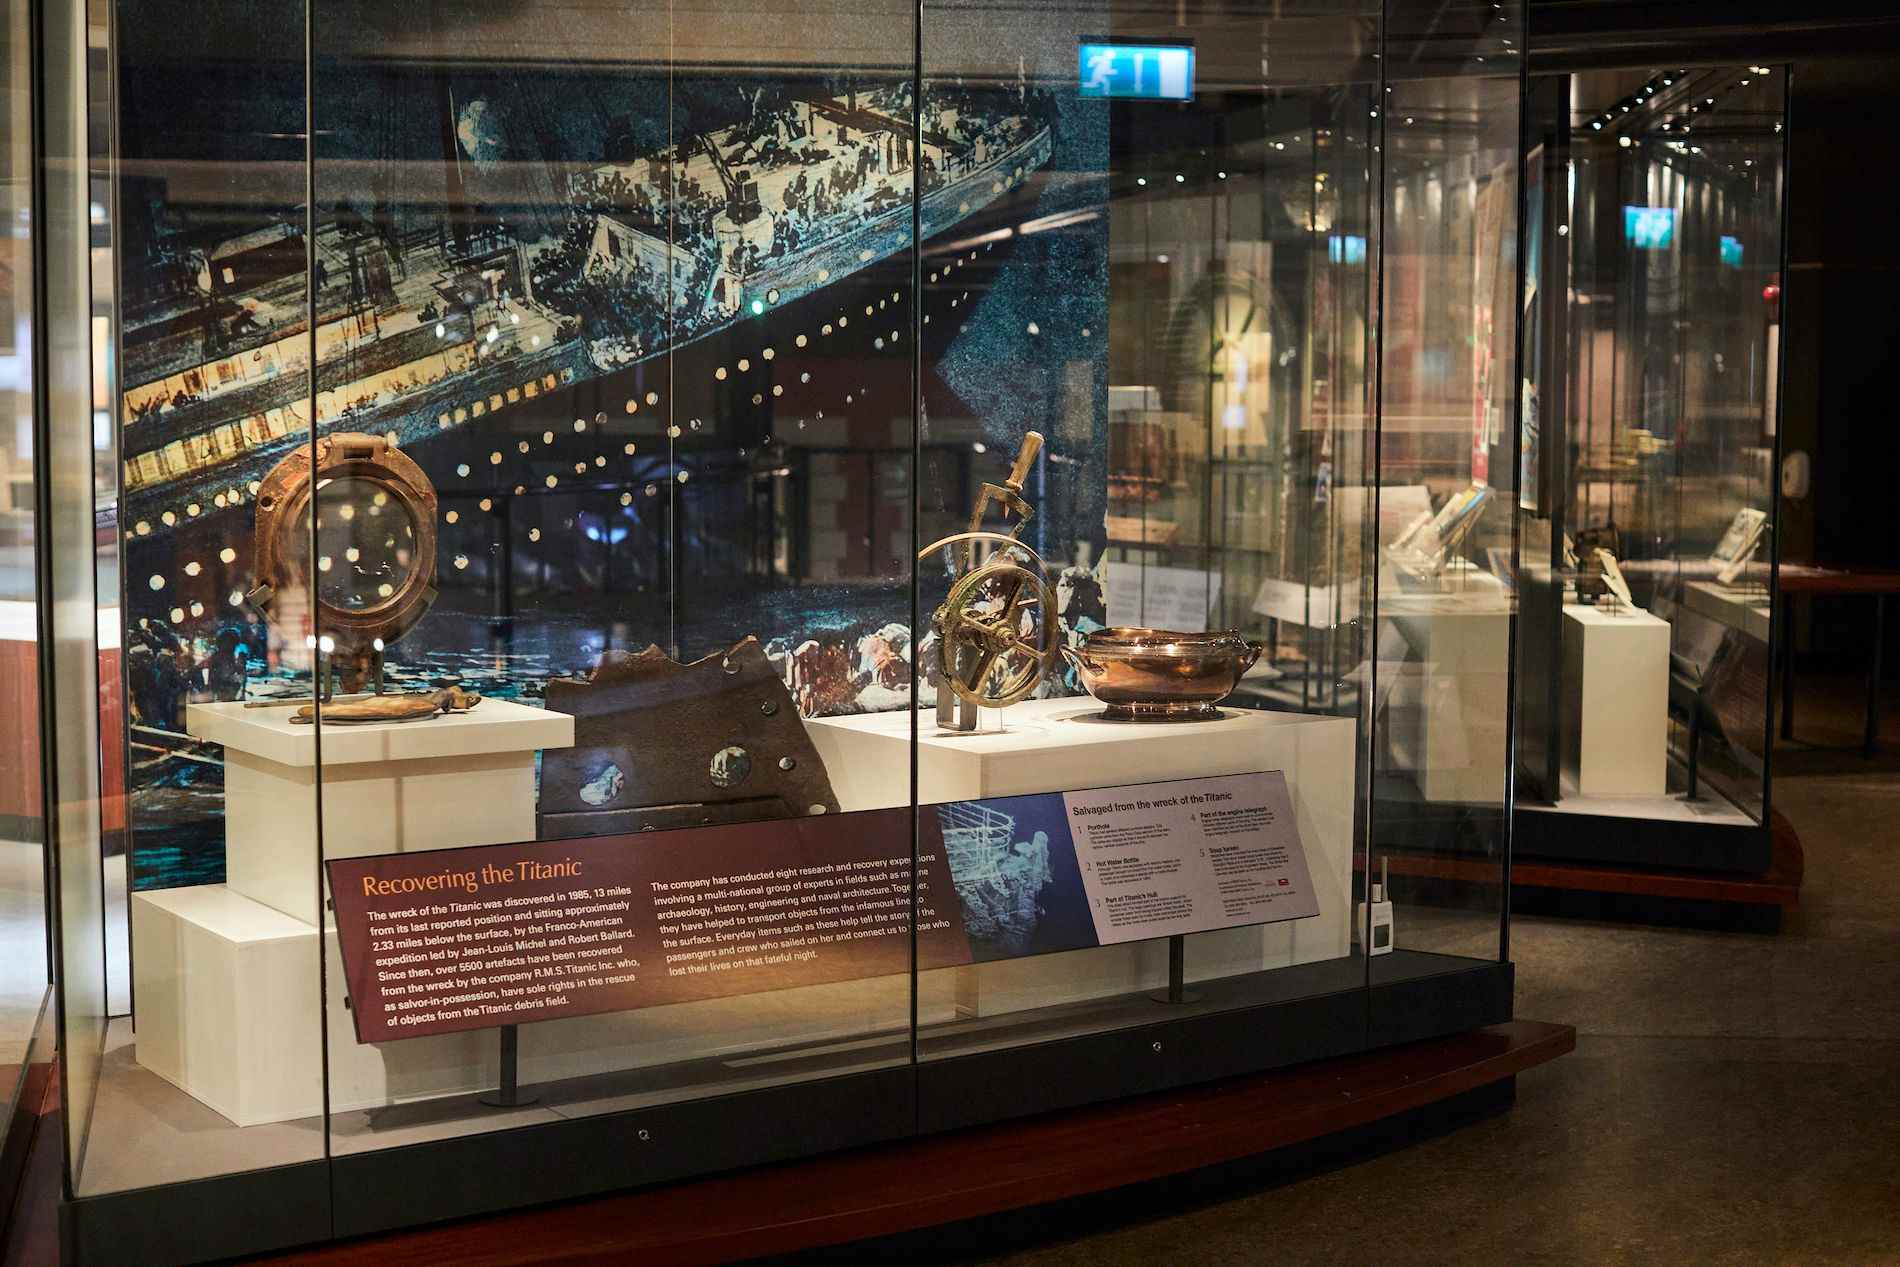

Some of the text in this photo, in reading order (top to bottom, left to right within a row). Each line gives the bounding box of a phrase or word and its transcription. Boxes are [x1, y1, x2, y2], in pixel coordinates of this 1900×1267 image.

[1072, 791, 1232, 816] Salvaged from the wreck of the Titanic
[363, 857, 581, 895] Recovering the Titanic
[650, 853, 935, 891] The company has conducted eight research and recovery expeions
[654, 893, 695, 906] involving
[704, 885, 764, 900] multi-national
[766, 884, 791, 896] group
[793, 881, 801, 890] of
[803, 878, 833, 891] experts
[836, 876, 843, 885] in
[845, 874, 867, 884] fields
[869, 871, 887, 882] such
[889, 872, 899, 880] as
[367, 886, 631, 921] The wreck of the Titanic was discovered in 1985, 13 miles
[370, 901, 630, 936] from its last reported position and sitting approximately
[659, 897, 912, 935] they have helped to transport objects from the infamous line
[748, 896, 798, 911] engineering
[800, 893, 816, 903] and
[818, 890, 840, 901] naval
[372, 916, 622, 950] 2.33 miles below the surface, by the Franco-American
[662, 938, 677, 948] the
[716, 929, 755, 942] Everyday
[757, 927, 782, 937] items
[783, 922, 803, 933] such
[805, 923, 814, 931] as
[816, 920, 838, 929] these
[840, 916, 858, 927] help
[859, 914, 873, 924] tell
[875, 913, 888, 922] the
[921, 907, 935, 917] the
[666, 919, 950, 965] passengers and crew who sailed on her and connect us to who
[375, 929, 634, 967] expedition led by Jean-Louis Michel and Robert Ballard.
[378, 970, 405, 980] Since
[407, 967, 433, 977] then,
[435, 965, 457, 974] over
[485, 955, 525, 968] artefacts
[527, 954, 549, 963] have
[552, 951, 575, 961] been
[577, 944, 622, 958] recovered
[669, 966, 685, 977] lost
[687, 964, 707, 974] their
[710, 962, 730, 972] lives
[732, 961, 743, 969] on
[745, 956, 763, 967] that
[764, 952, 792, 964] fateful
[381, 986, 405, 995] from
[407, 982, 423, 992] the
[425, 978, 455, 990] wreck
[456, 977, 468, 989] by
[470, 975, 486, 985] the
[488, 971, 532, 984] company
[565, 962, 597, 974] Titanic
[599, 961, 614, 970] Inc.
[616, 958, 640, 968] who,
[384, 1002, 396, 1010] as
[501, 987, 524, 996] have
[526, 983, 546, 993] sole
[548, 979, 574, 993] rights
[576, 978, 585, 987] in
[588, 976, 603, 986] the
[605, 973, 635, 984] rescue
[387, 994, 569, 1026] of objects from the Titanic debris field.
